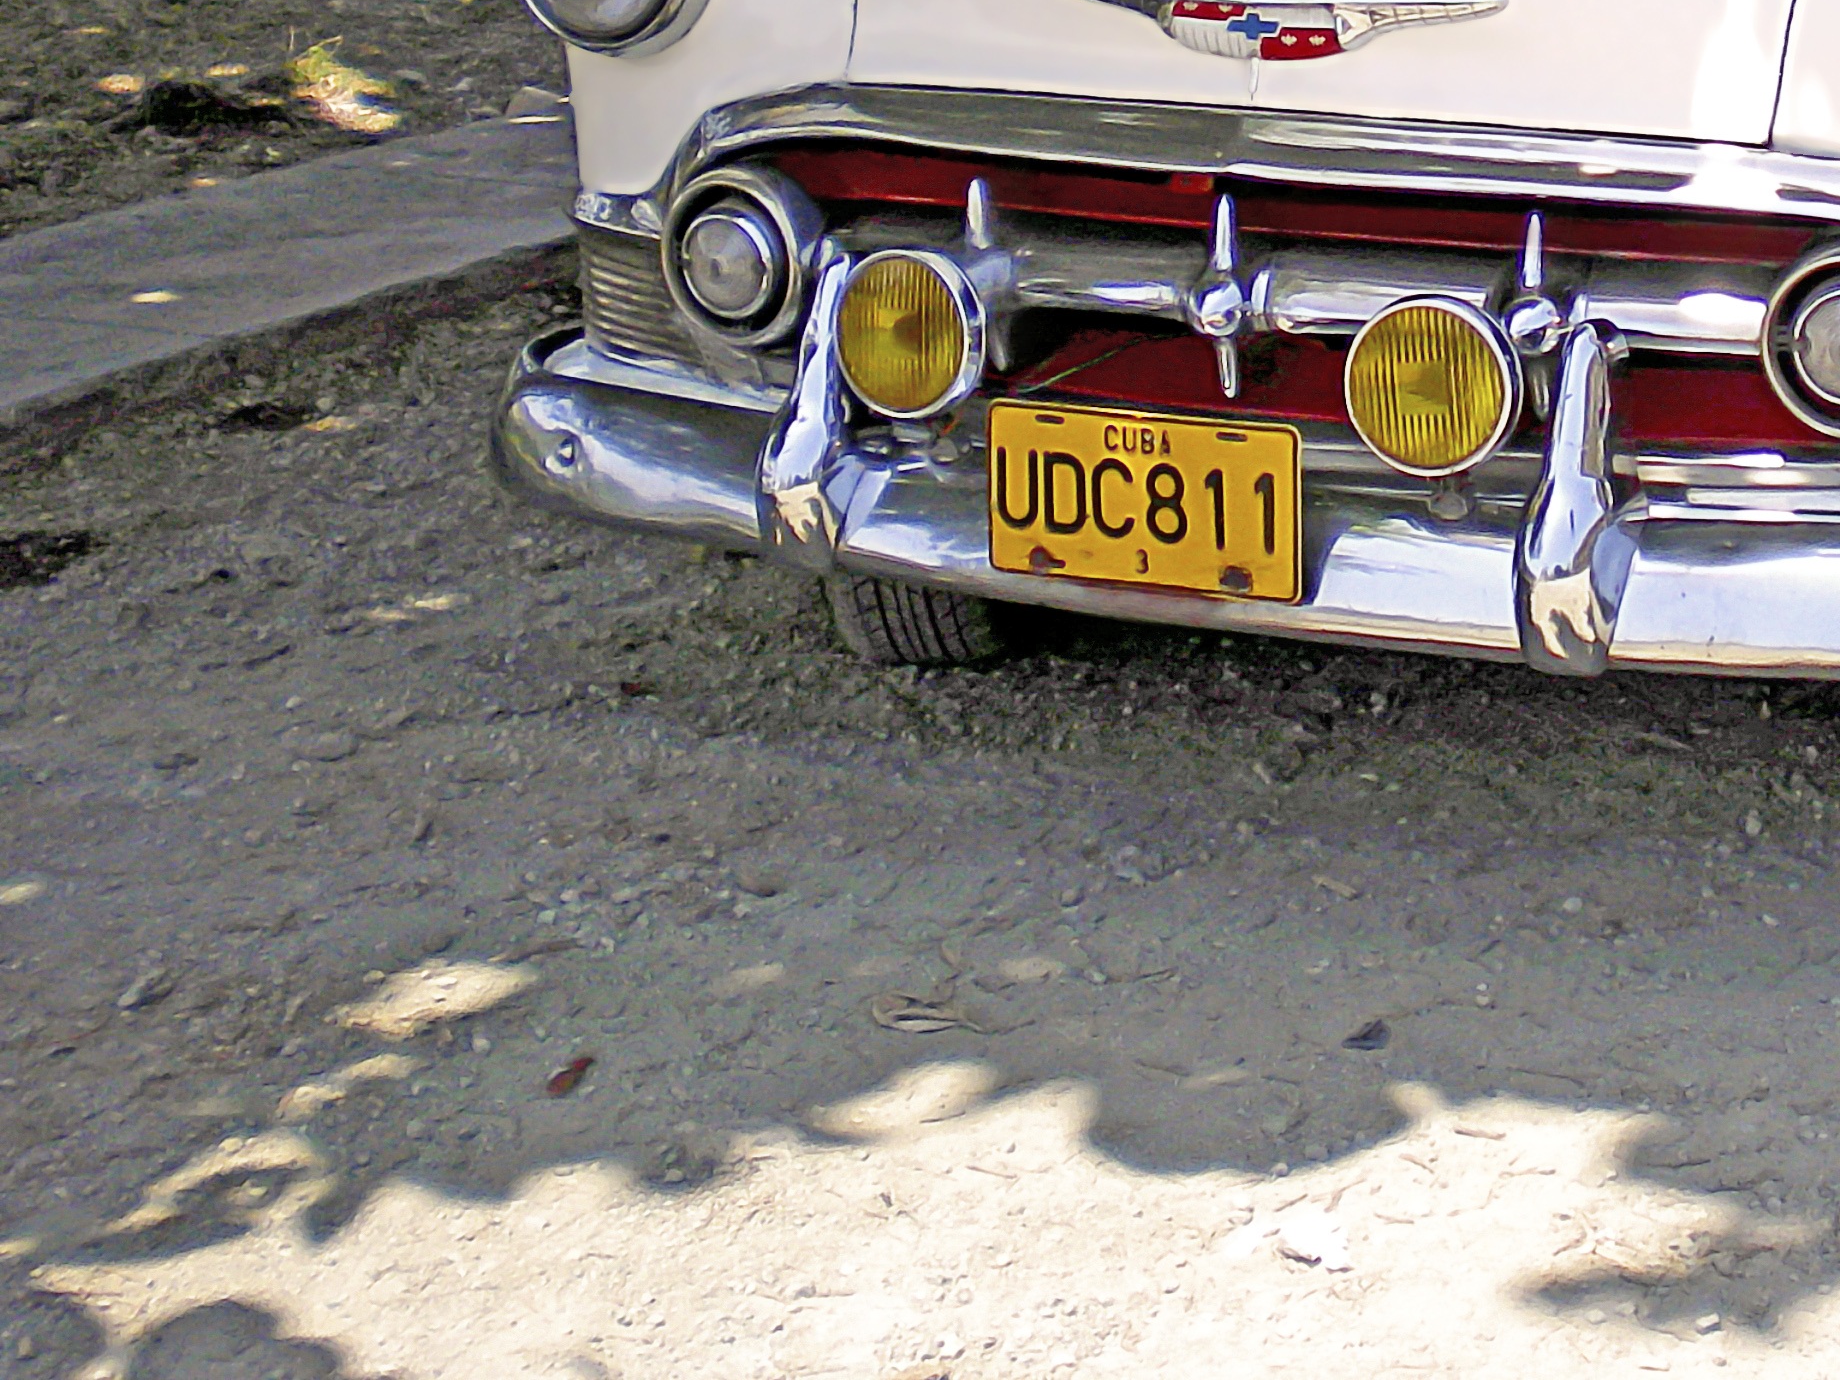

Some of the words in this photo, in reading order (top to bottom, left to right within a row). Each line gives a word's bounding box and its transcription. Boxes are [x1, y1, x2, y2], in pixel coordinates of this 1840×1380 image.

[1104, 425, 1171, 454] CUBA
[997, 447, 1276, 555] UDC811
[1135, 549, 1149, 573] 3
